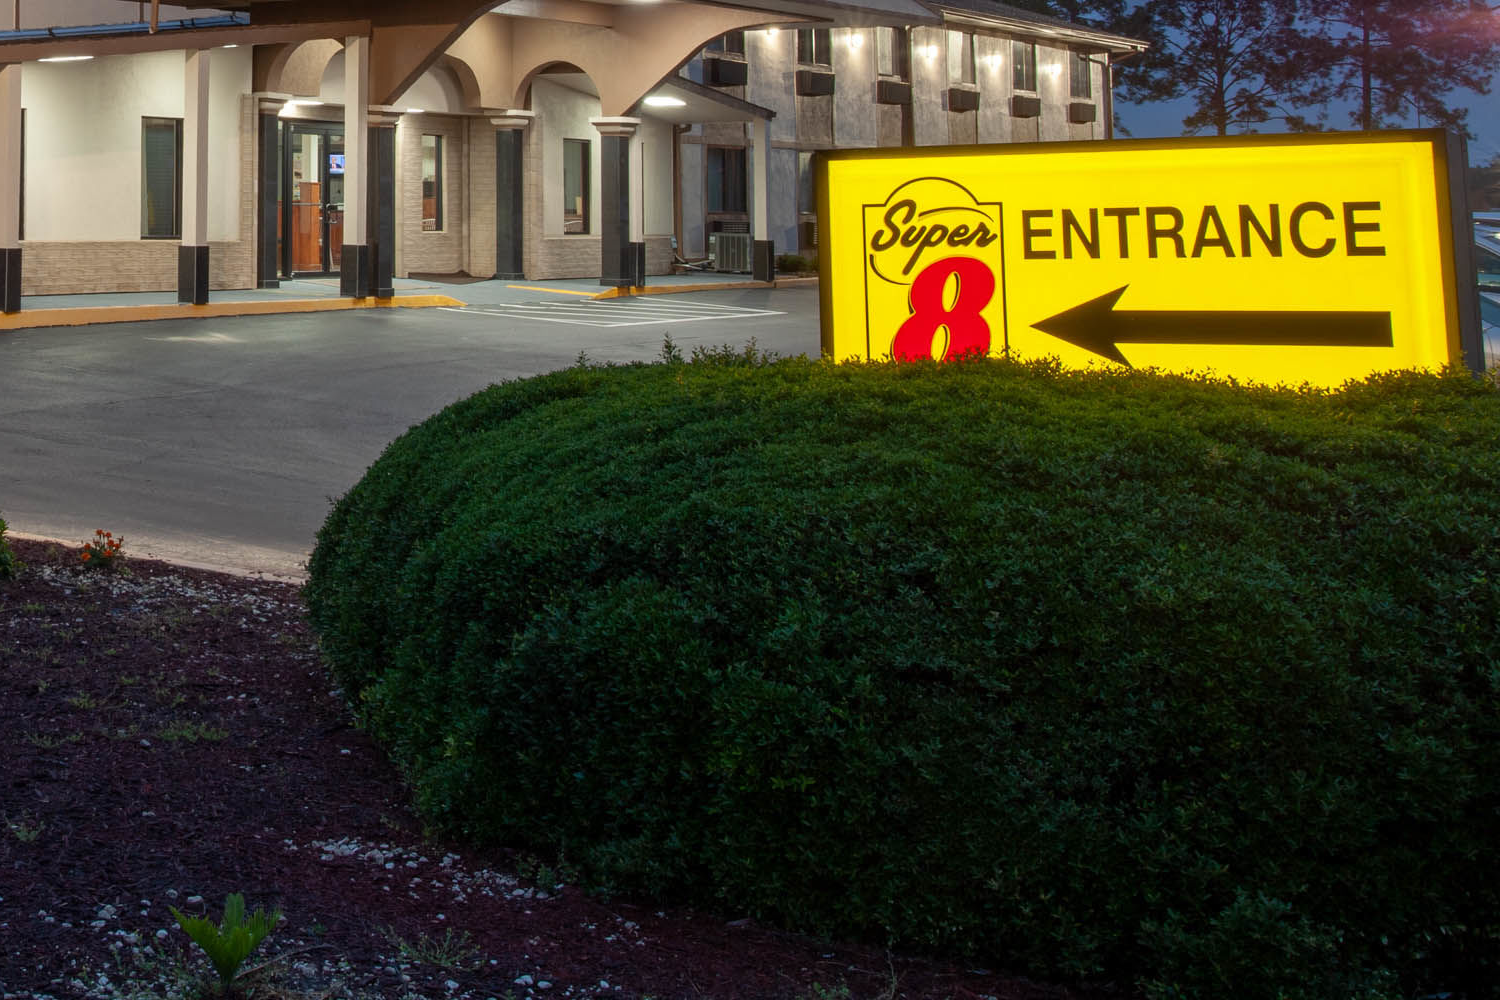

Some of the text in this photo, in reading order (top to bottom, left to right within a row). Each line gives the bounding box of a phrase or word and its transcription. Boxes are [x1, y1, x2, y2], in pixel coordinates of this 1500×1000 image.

[870, 199, 998, 276] Super
[1021, 201, 1387, 260] ENTRANCE
[891, 256, 996, 364] 8
